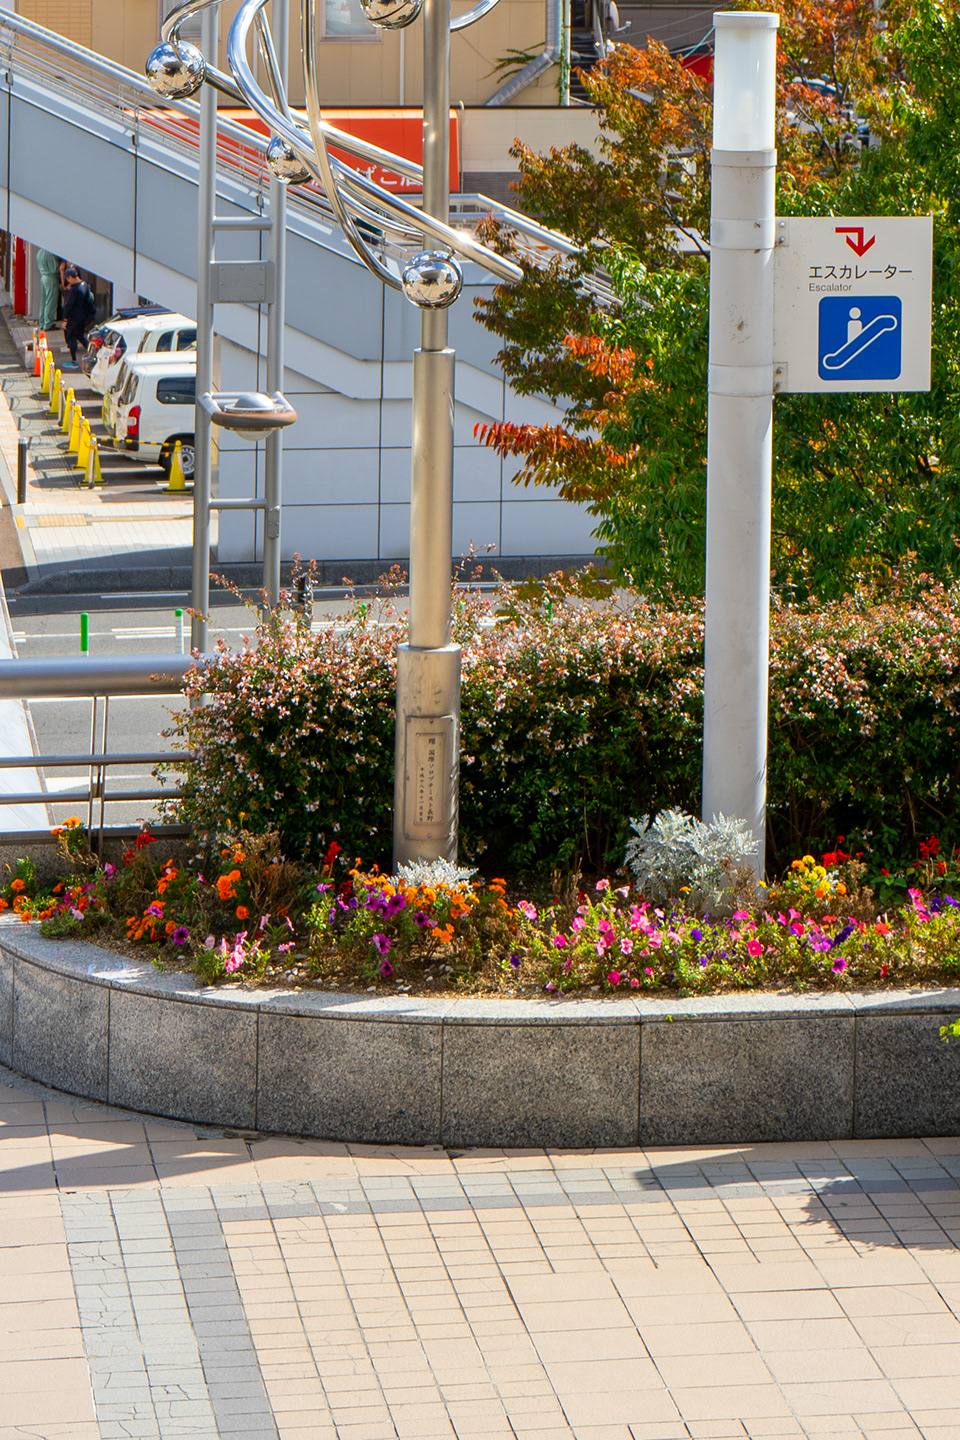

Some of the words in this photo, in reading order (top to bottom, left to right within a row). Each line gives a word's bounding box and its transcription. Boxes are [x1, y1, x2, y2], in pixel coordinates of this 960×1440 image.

[808, 264, 912, 280] エスカレーター
[809, 282, 852, 292] Escalator
